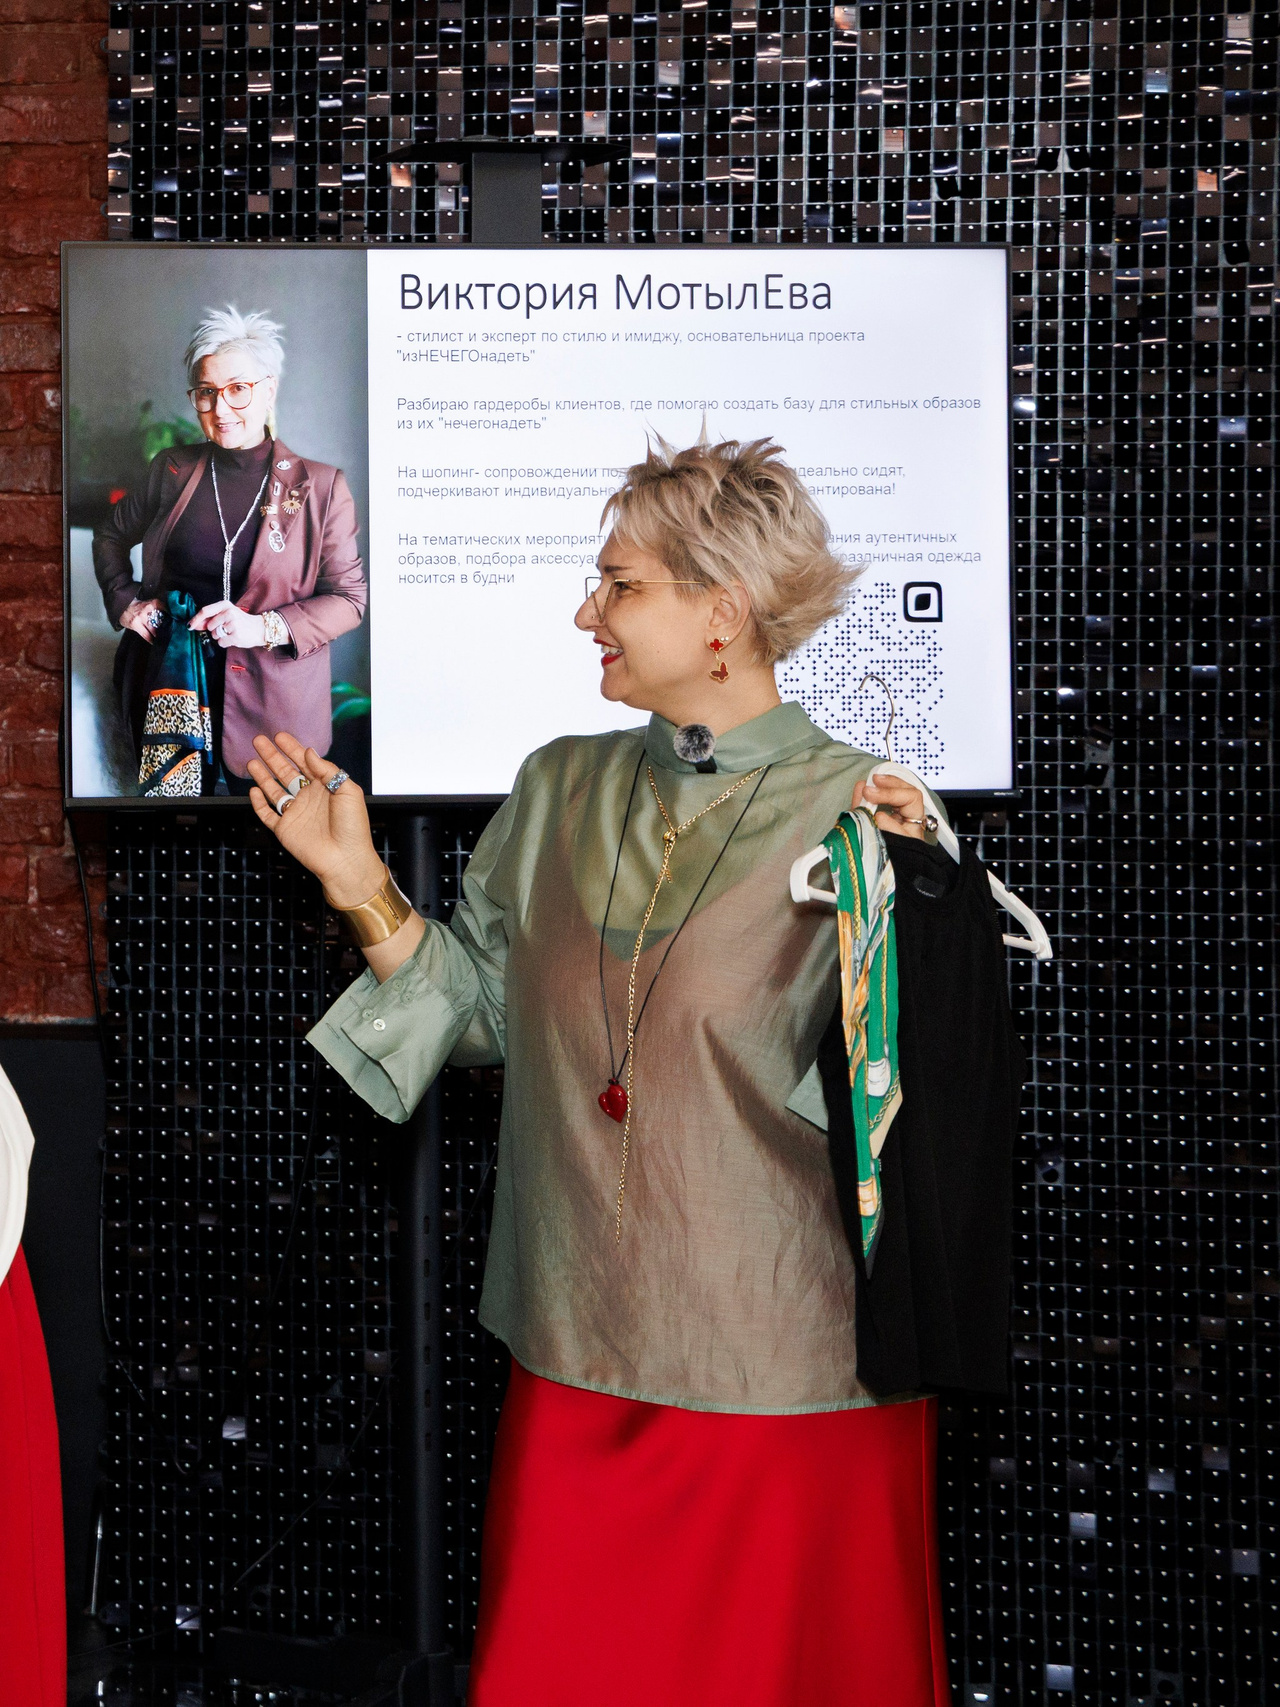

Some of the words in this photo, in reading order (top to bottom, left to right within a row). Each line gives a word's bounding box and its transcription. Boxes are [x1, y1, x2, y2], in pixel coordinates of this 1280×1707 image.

[400, 273, 598, 320] Виктория
[615, 273, 832, 311] МотылЕва
[406, 332, 465, 343] стилист
[468, 332, 477, 343] и
[481, 332, 537, 345] эксперт
[541, 332, 559, 343] по
[562, 332, 607, 343] стилю
[611, 332, 620, 342] и
[624, 332, 683, 346] имиджу,
[686, 332, 804, 344] основательница
[808, 331, 866, 344] проекта
[396, 348, 536, 364] "изНЕЧЕГОнадеть"
[397, 397, 469, 412] Разбираю
[473, 397, 551, 412] гардеробы
[555, 399, 625, 412] клиентов,
[630, 399, 653, 412] где
[657, 399, 719, 411] помогаю
[723, 399, 780, 411] создать
[783, 396, 816, 413] базу
[818, 398, 846, 411] для
[849, 398, 919, 410] стильных
[922, 395, 982, 411] образов
[396, 419, 413, 430] из
[417, 419, 434, 430] их
[438, 416, 547, 431] "нечегонадеть"
[397, 465, 417, 479] На
[421, 468, 480, 479] шопинг-
[484, 467, 597, 481] сопровождении
[862, 466, 906, 479] сидят,
[397, 486, 501, 500] подчеркивают
[398, 532, 418, 546] На
[421, 535, 521, 546] тематических
[865, 532, 958, 546] аутентичных
[398, 551, 461, 568] образов,
[465, 551, 527, 567] подбора
[927, 551, 982, 564] одежда
[398, 573, 456, 584] носится
[460, 573, 469, 584] в
[472, 570, 515, 585] будни
